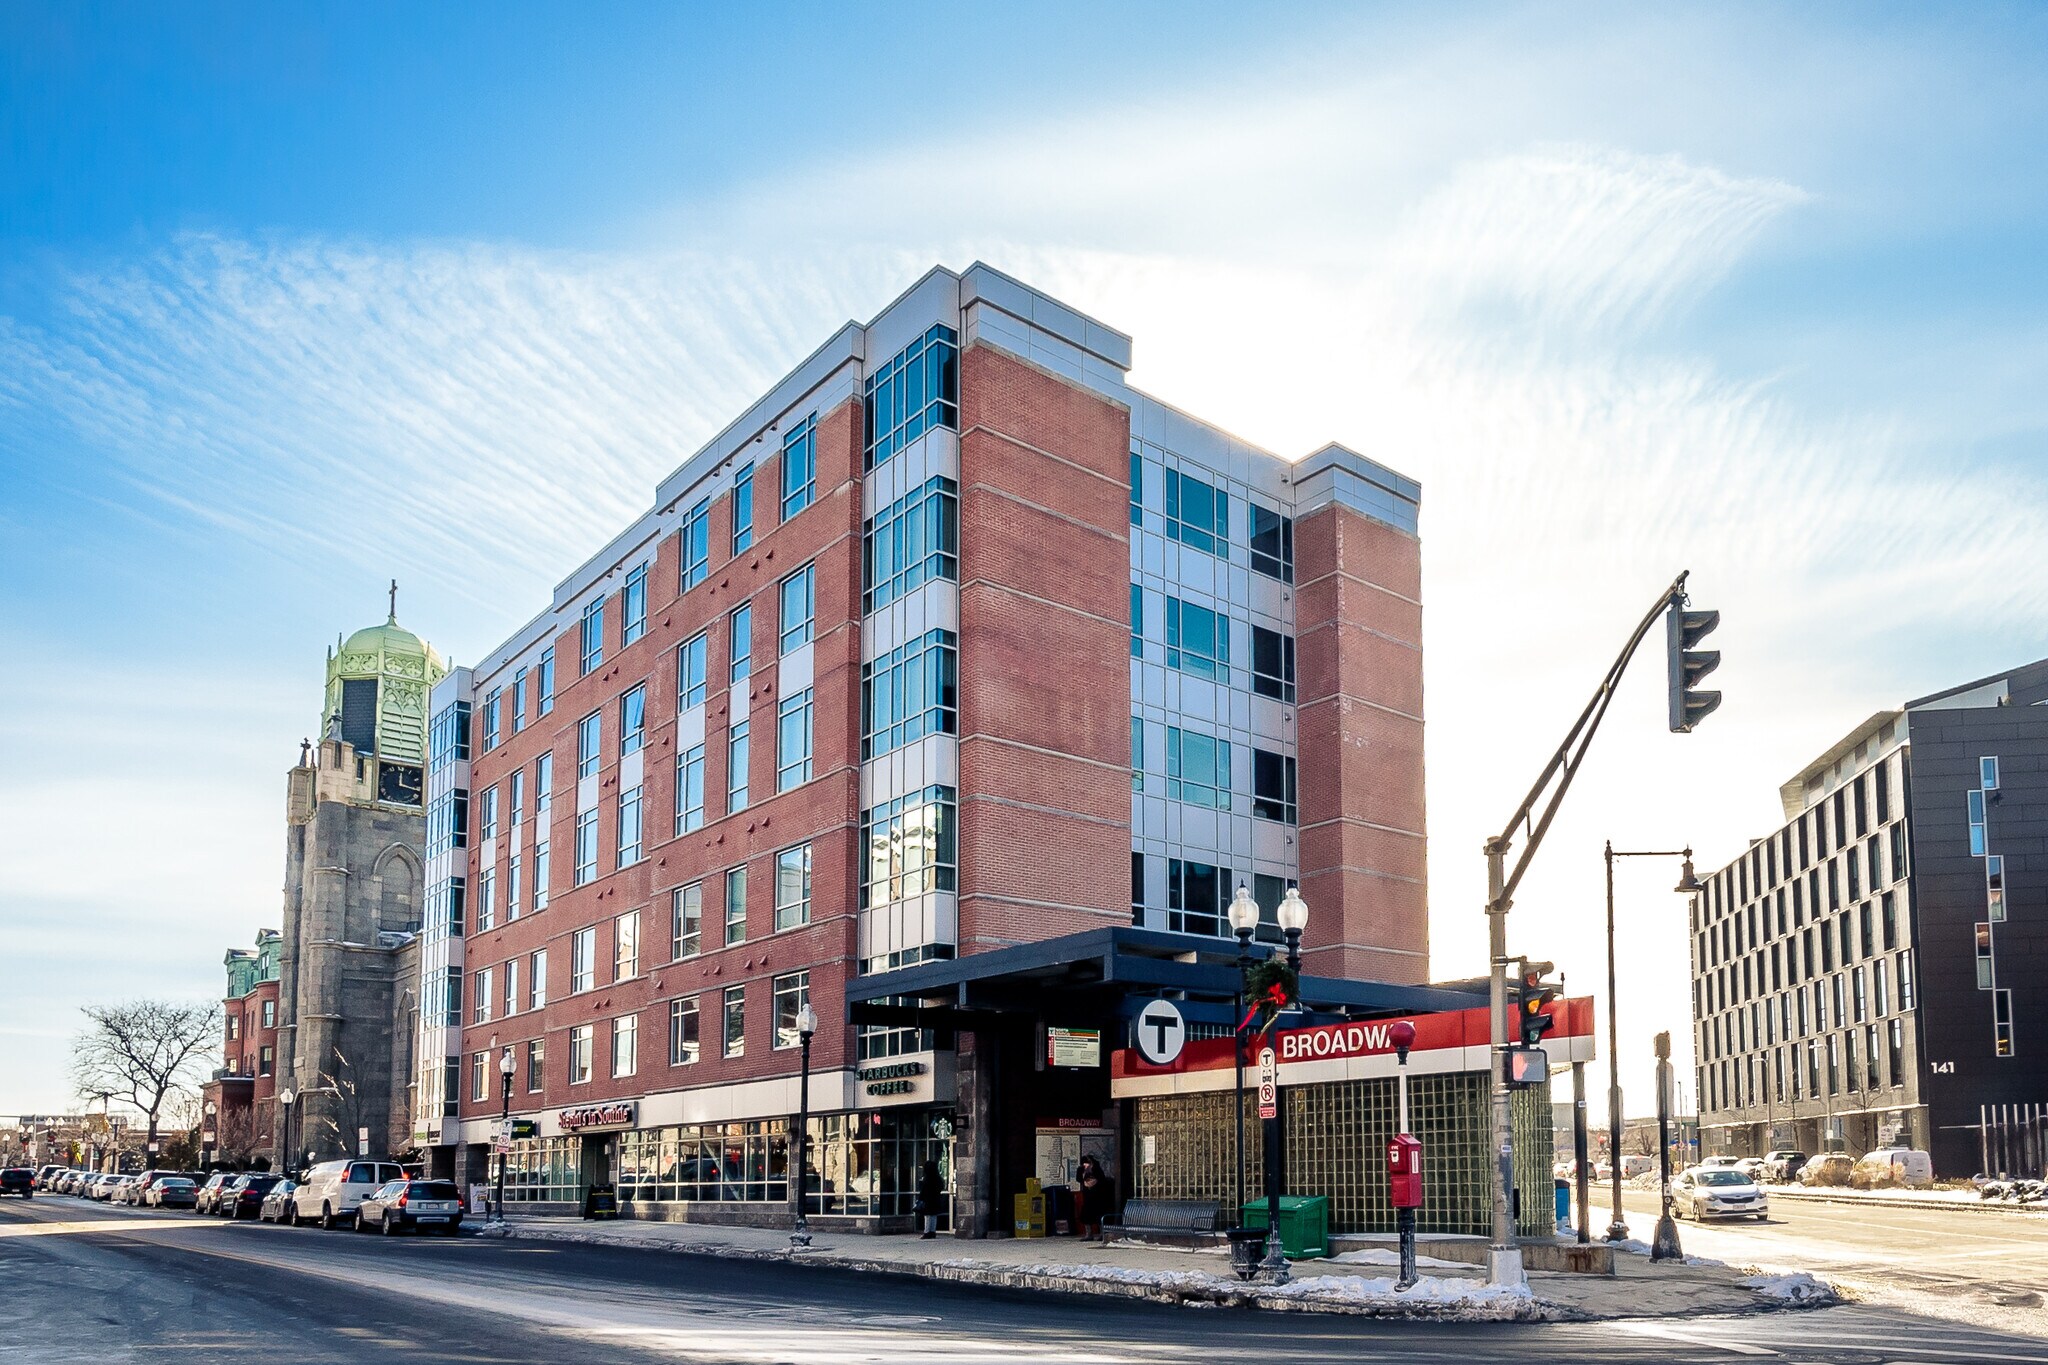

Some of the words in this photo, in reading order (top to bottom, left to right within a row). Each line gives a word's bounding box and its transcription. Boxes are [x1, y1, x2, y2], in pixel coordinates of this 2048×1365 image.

[1144, 1014, 1178, 1055] T
[1282, 1021, 1415, 1058] BROADW
[1263, 1054, 1271, 1065] T
[1930, 1061, 1955, 1074] 141
[855, 1062, 920, 1081] STARBUCKS
[866, 1081, 909, 1096] COFFEE
[598, 1106, 629, 1125] Southie
[1059, 1118, 1101, 1127] BROADWAY
